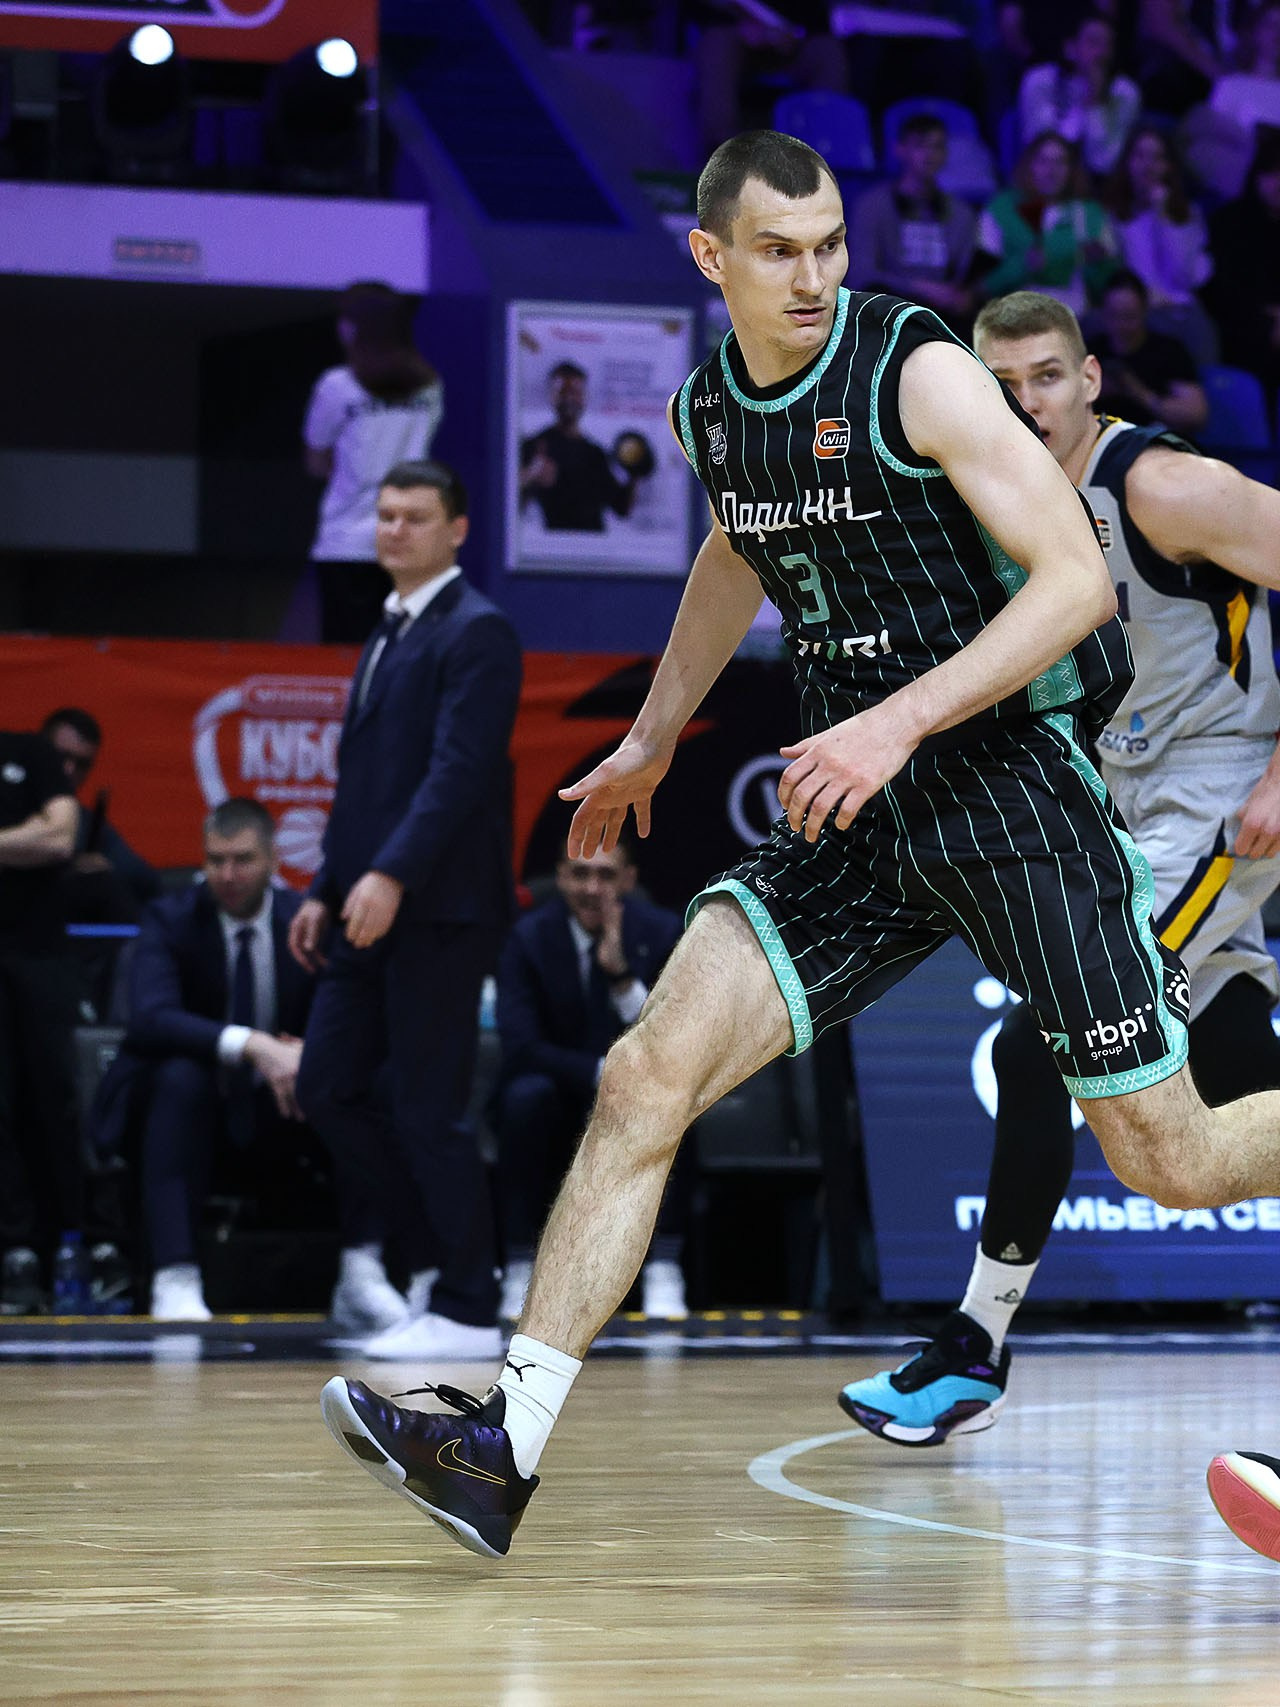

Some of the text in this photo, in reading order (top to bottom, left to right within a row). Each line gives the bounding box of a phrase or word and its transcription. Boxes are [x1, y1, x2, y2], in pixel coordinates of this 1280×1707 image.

[822, 433, 847, 446] Win
[721, 491, 800, 543] Пари
[779, 552, 830, 624] 3
[1084, 1003, 1153, 1048] rbpi
[1090, 1045, 1123, 1061] group
[954, 1195, 1219, 1232] ПМЬЕРА
